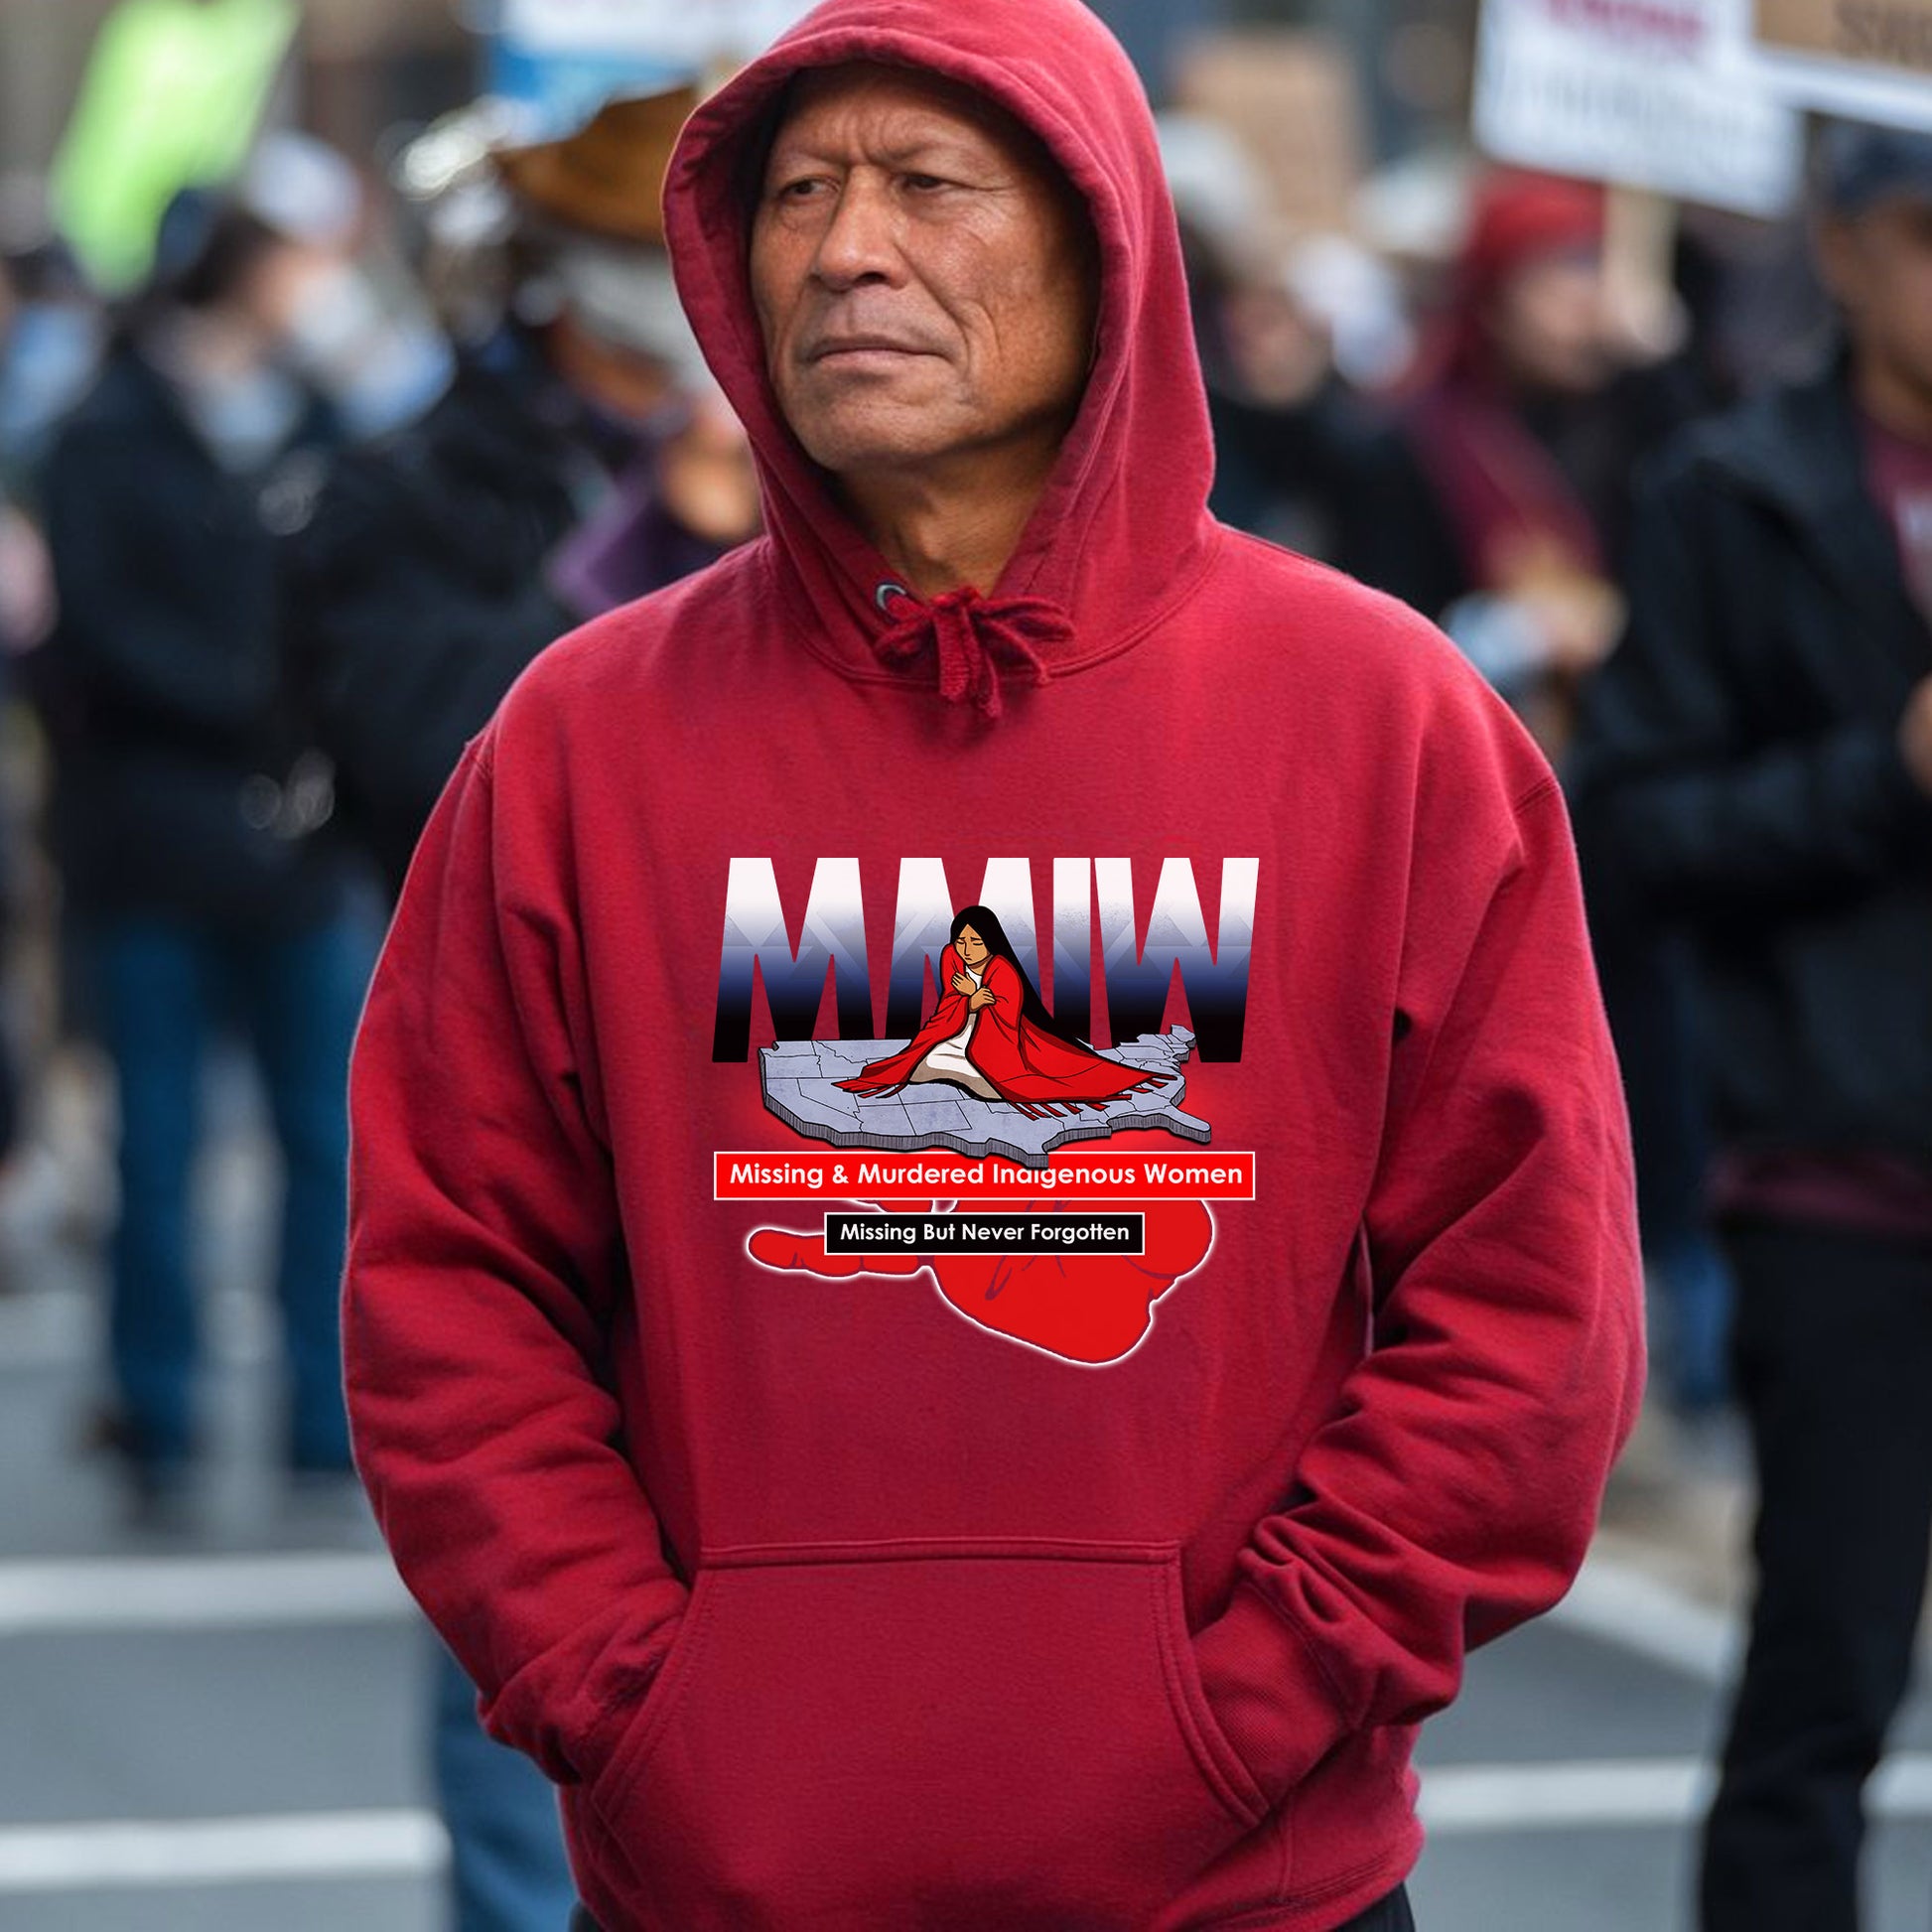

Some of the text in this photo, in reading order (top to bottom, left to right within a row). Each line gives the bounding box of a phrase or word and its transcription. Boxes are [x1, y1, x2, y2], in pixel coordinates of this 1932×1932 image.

[712, 857, 1260, 1062] MMIW
[730, 1163, 1242, 1189] Missing & Murdered Indigenous Women
[840, 1222, 1130, 1245] Missing But Never Forgotten
